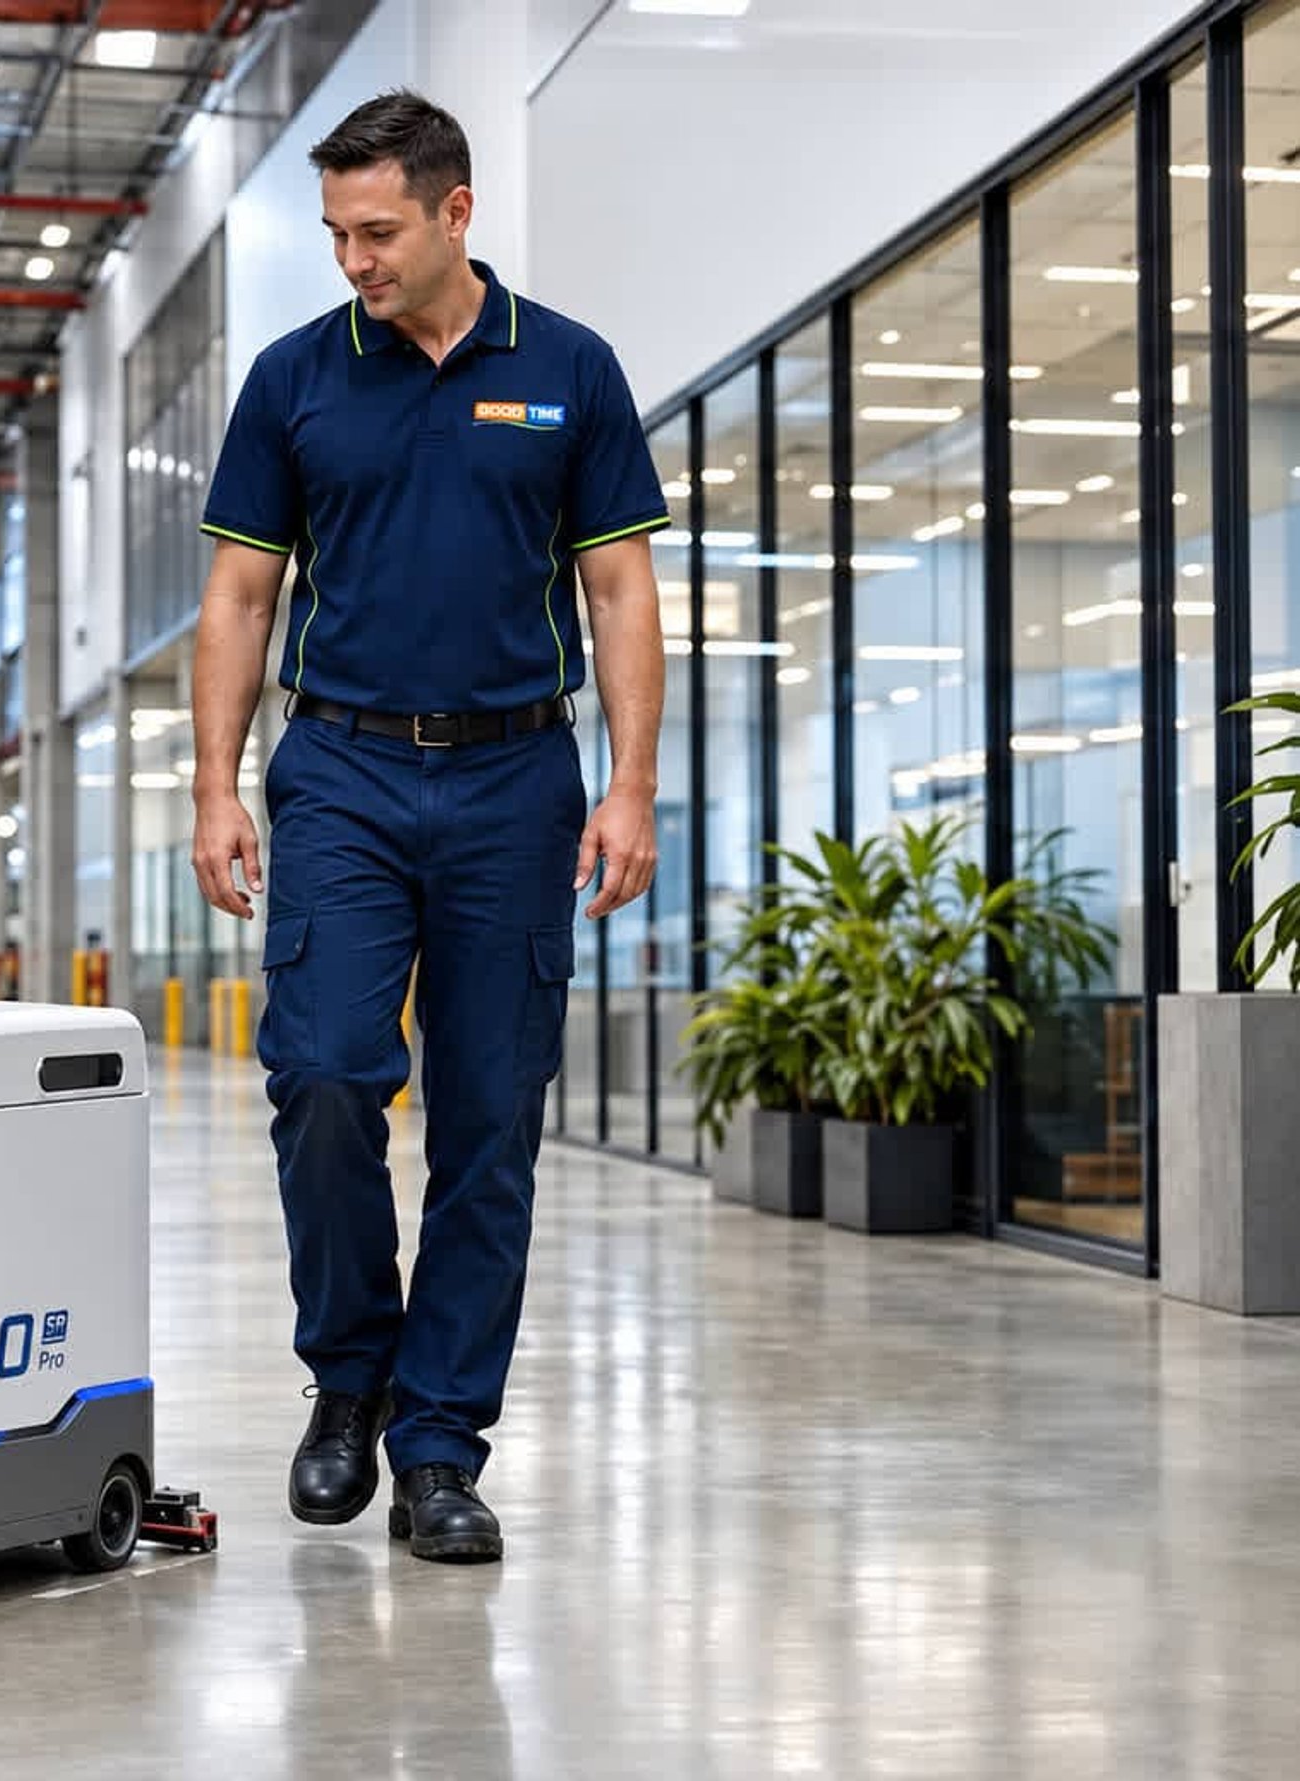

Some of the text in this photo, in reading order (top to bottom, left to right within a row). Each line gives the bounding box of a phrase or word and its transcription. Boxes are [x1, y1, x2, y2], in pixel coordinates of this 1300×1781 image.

[476, 404, 565, 421] GOOD TIME
[38, 1351, 65, 1371] Pro
